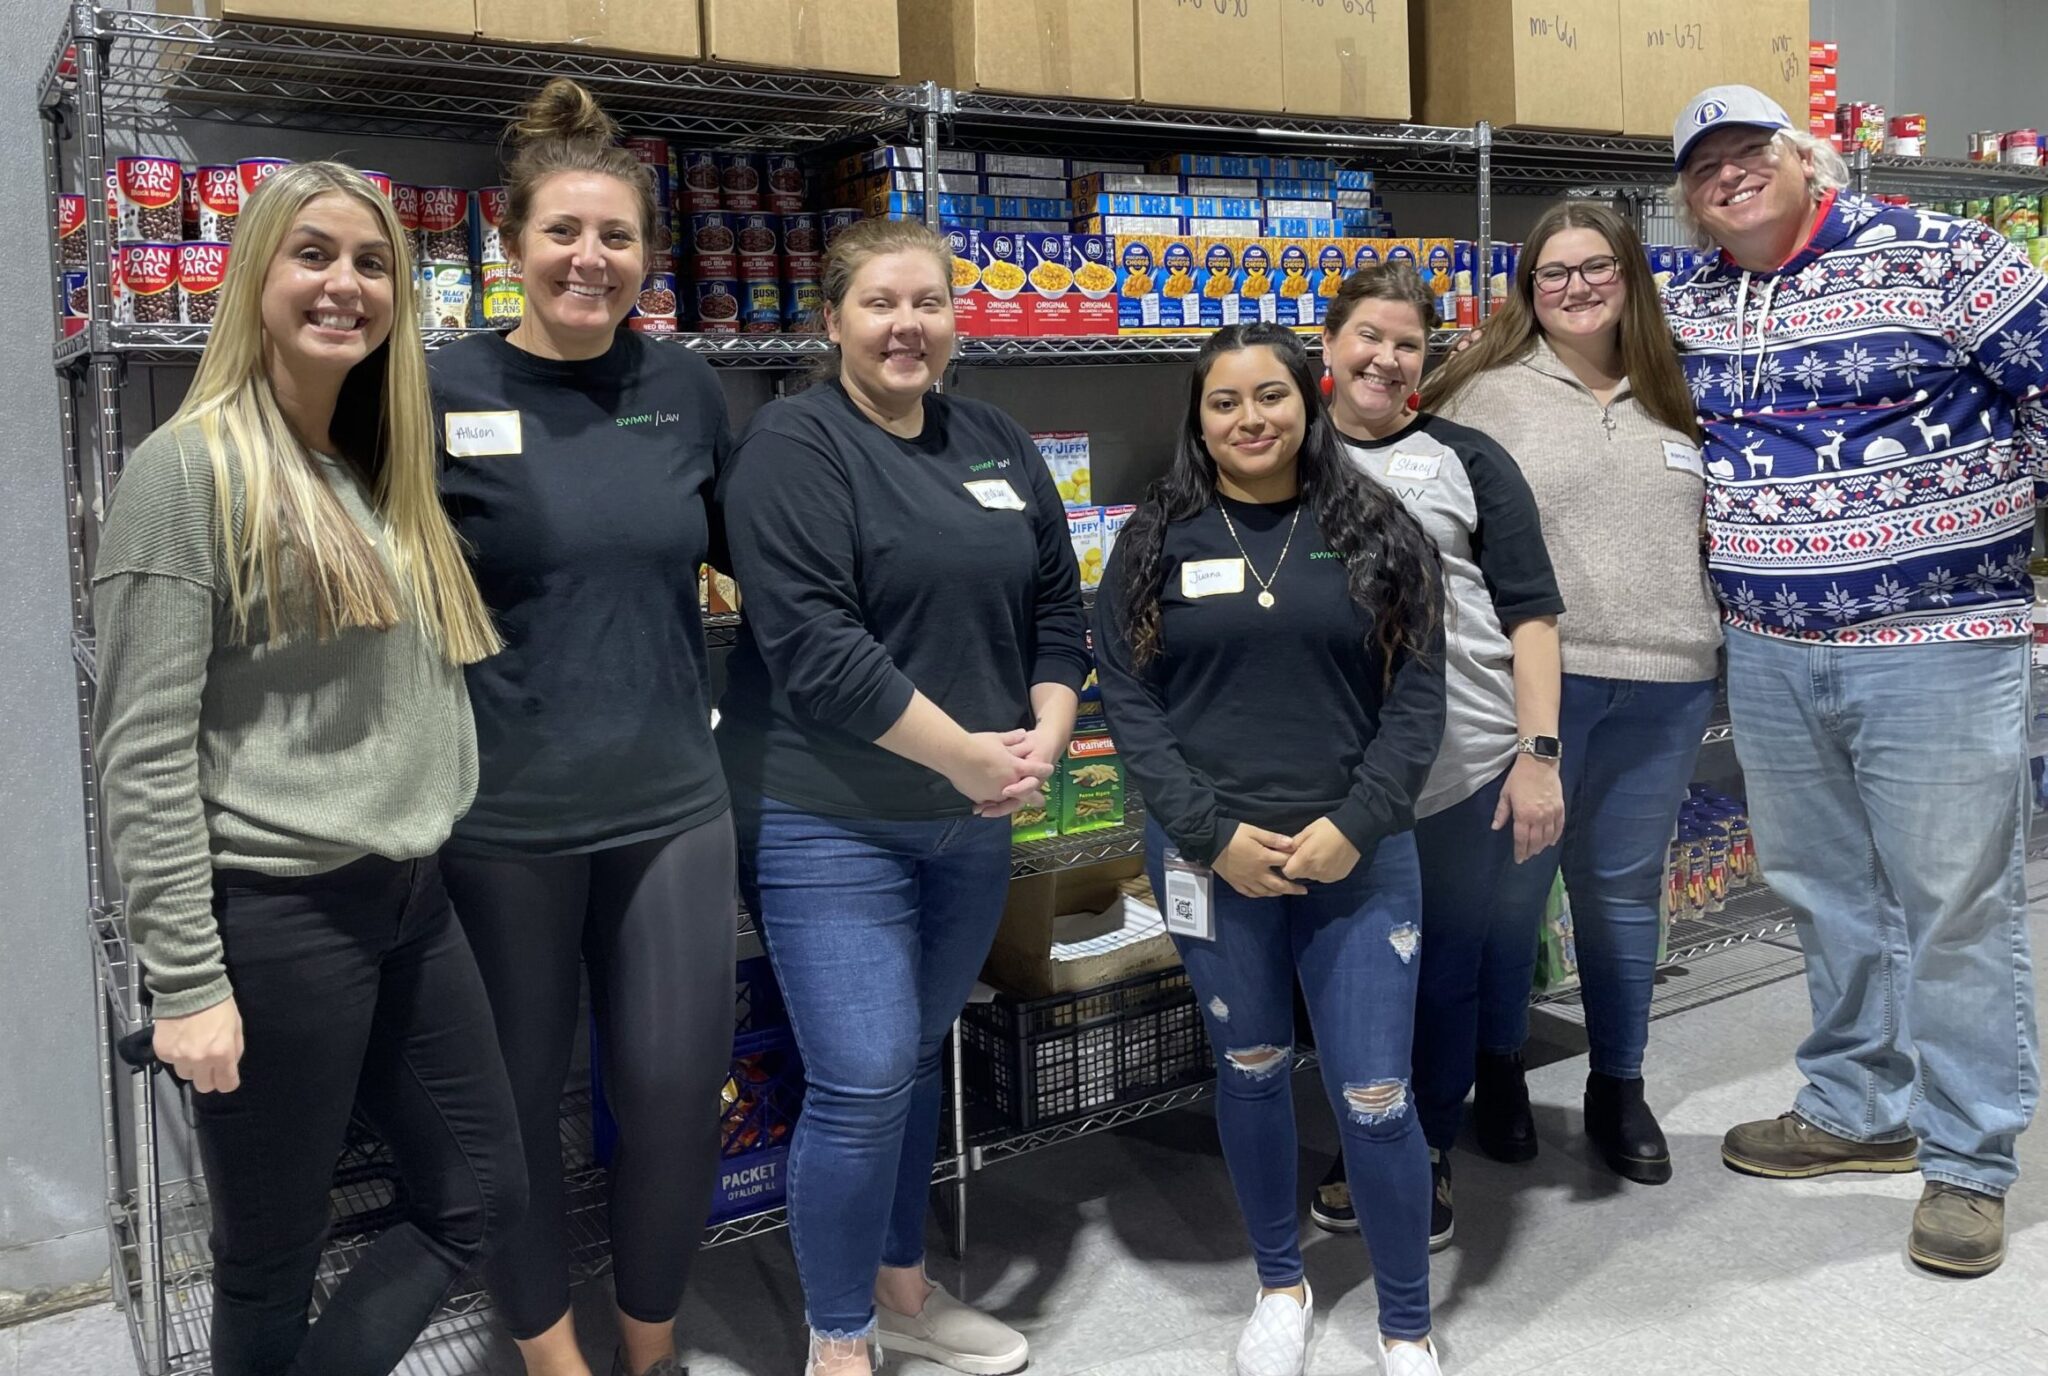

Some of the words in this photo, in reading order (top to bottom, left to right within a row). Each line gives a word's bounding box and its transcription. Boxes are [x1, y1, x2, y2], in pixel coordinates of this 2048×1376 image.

[1705, 103, 1717, 121] B
[126, 161, 174, 179] JOAN
[134, 175, 172, 191] ARC
[205, 170, 237, 189] JOA
[212, 184, 238, 198] AR
[420, 191, 458, 205] JOAN
[424, 203, 455, 217] ARC
[124, 247, 171, 265] JOAN
[179, 247, 222, 265] JOAN
[131, 261, 167, 277] ARC
[184, 261, 219, 276] ARC
[492, 297, 520, 306] BLACK
[987, 301, 1021, 309] ORIGINAL
[1036, 301, 1069, 309] ORIGINAL
[1080, 301, 1112, 309] ORIGINAL
[492, 305, 520, 314] BEANS
[616, 414, 652, 427] SWMW
[1056, 442, 1087, 454] JIFFY
[1070, 522, 1098, 534] JIFFY
[722, 1162, 777, 1190] PACKET
